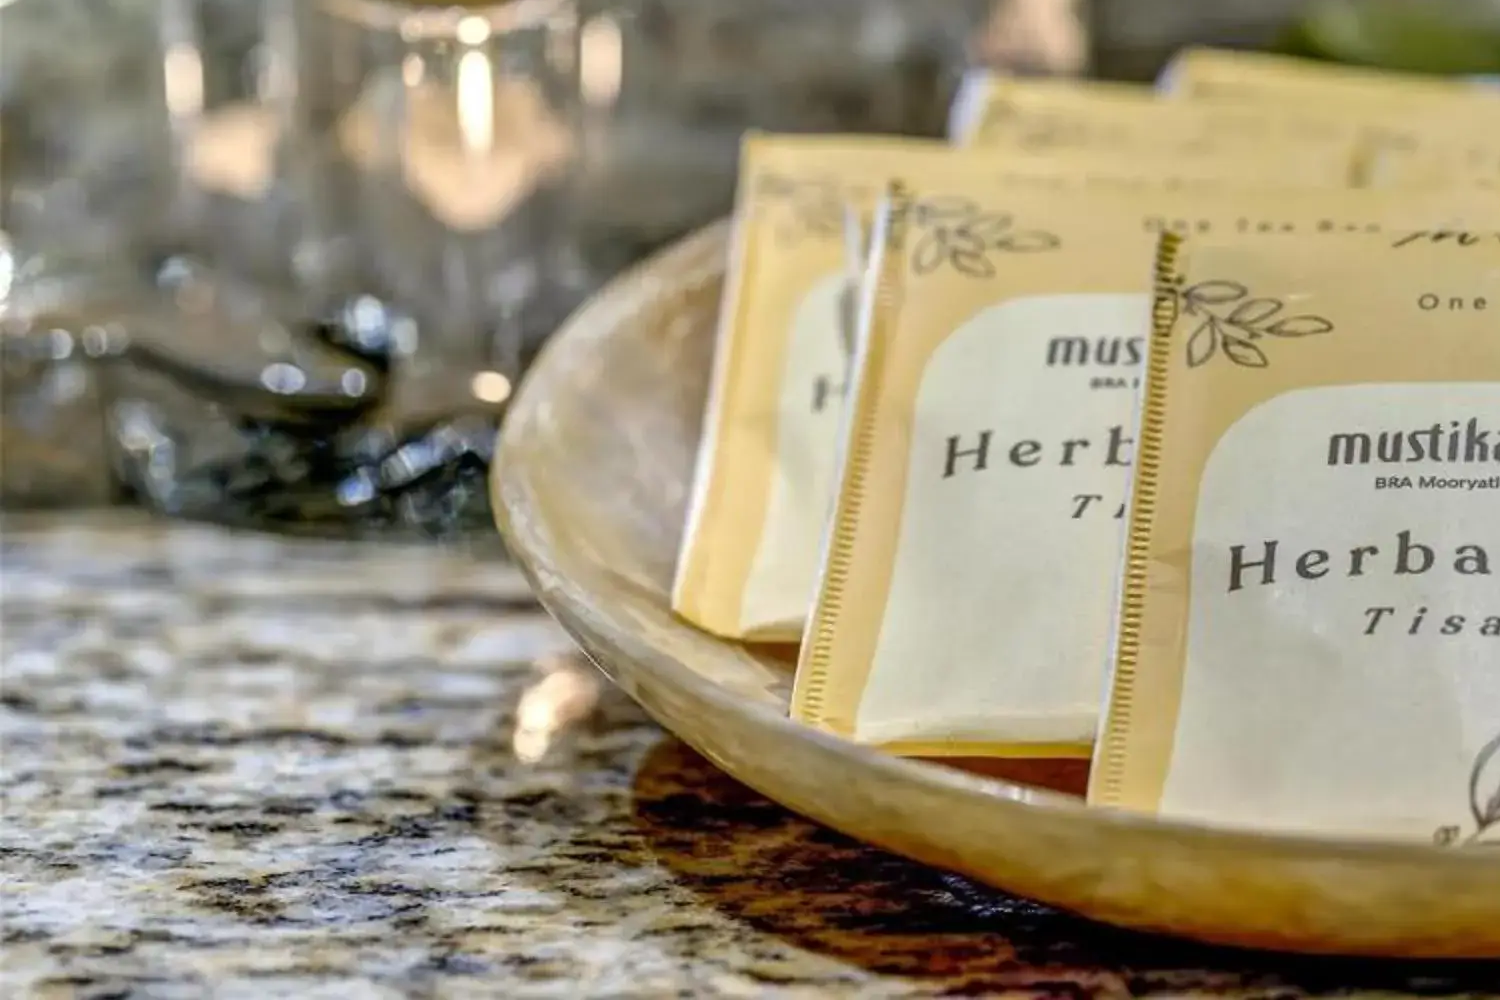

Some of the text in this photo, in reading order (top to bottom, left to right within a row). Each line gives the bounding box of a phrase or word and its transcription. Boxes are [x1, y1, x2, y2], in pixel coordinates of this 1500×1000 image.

[1416, 293, 1488, 311] One
[1375, 475, 1413, 490] BRA
[1418, 475, 1500, 492] Mooryati
